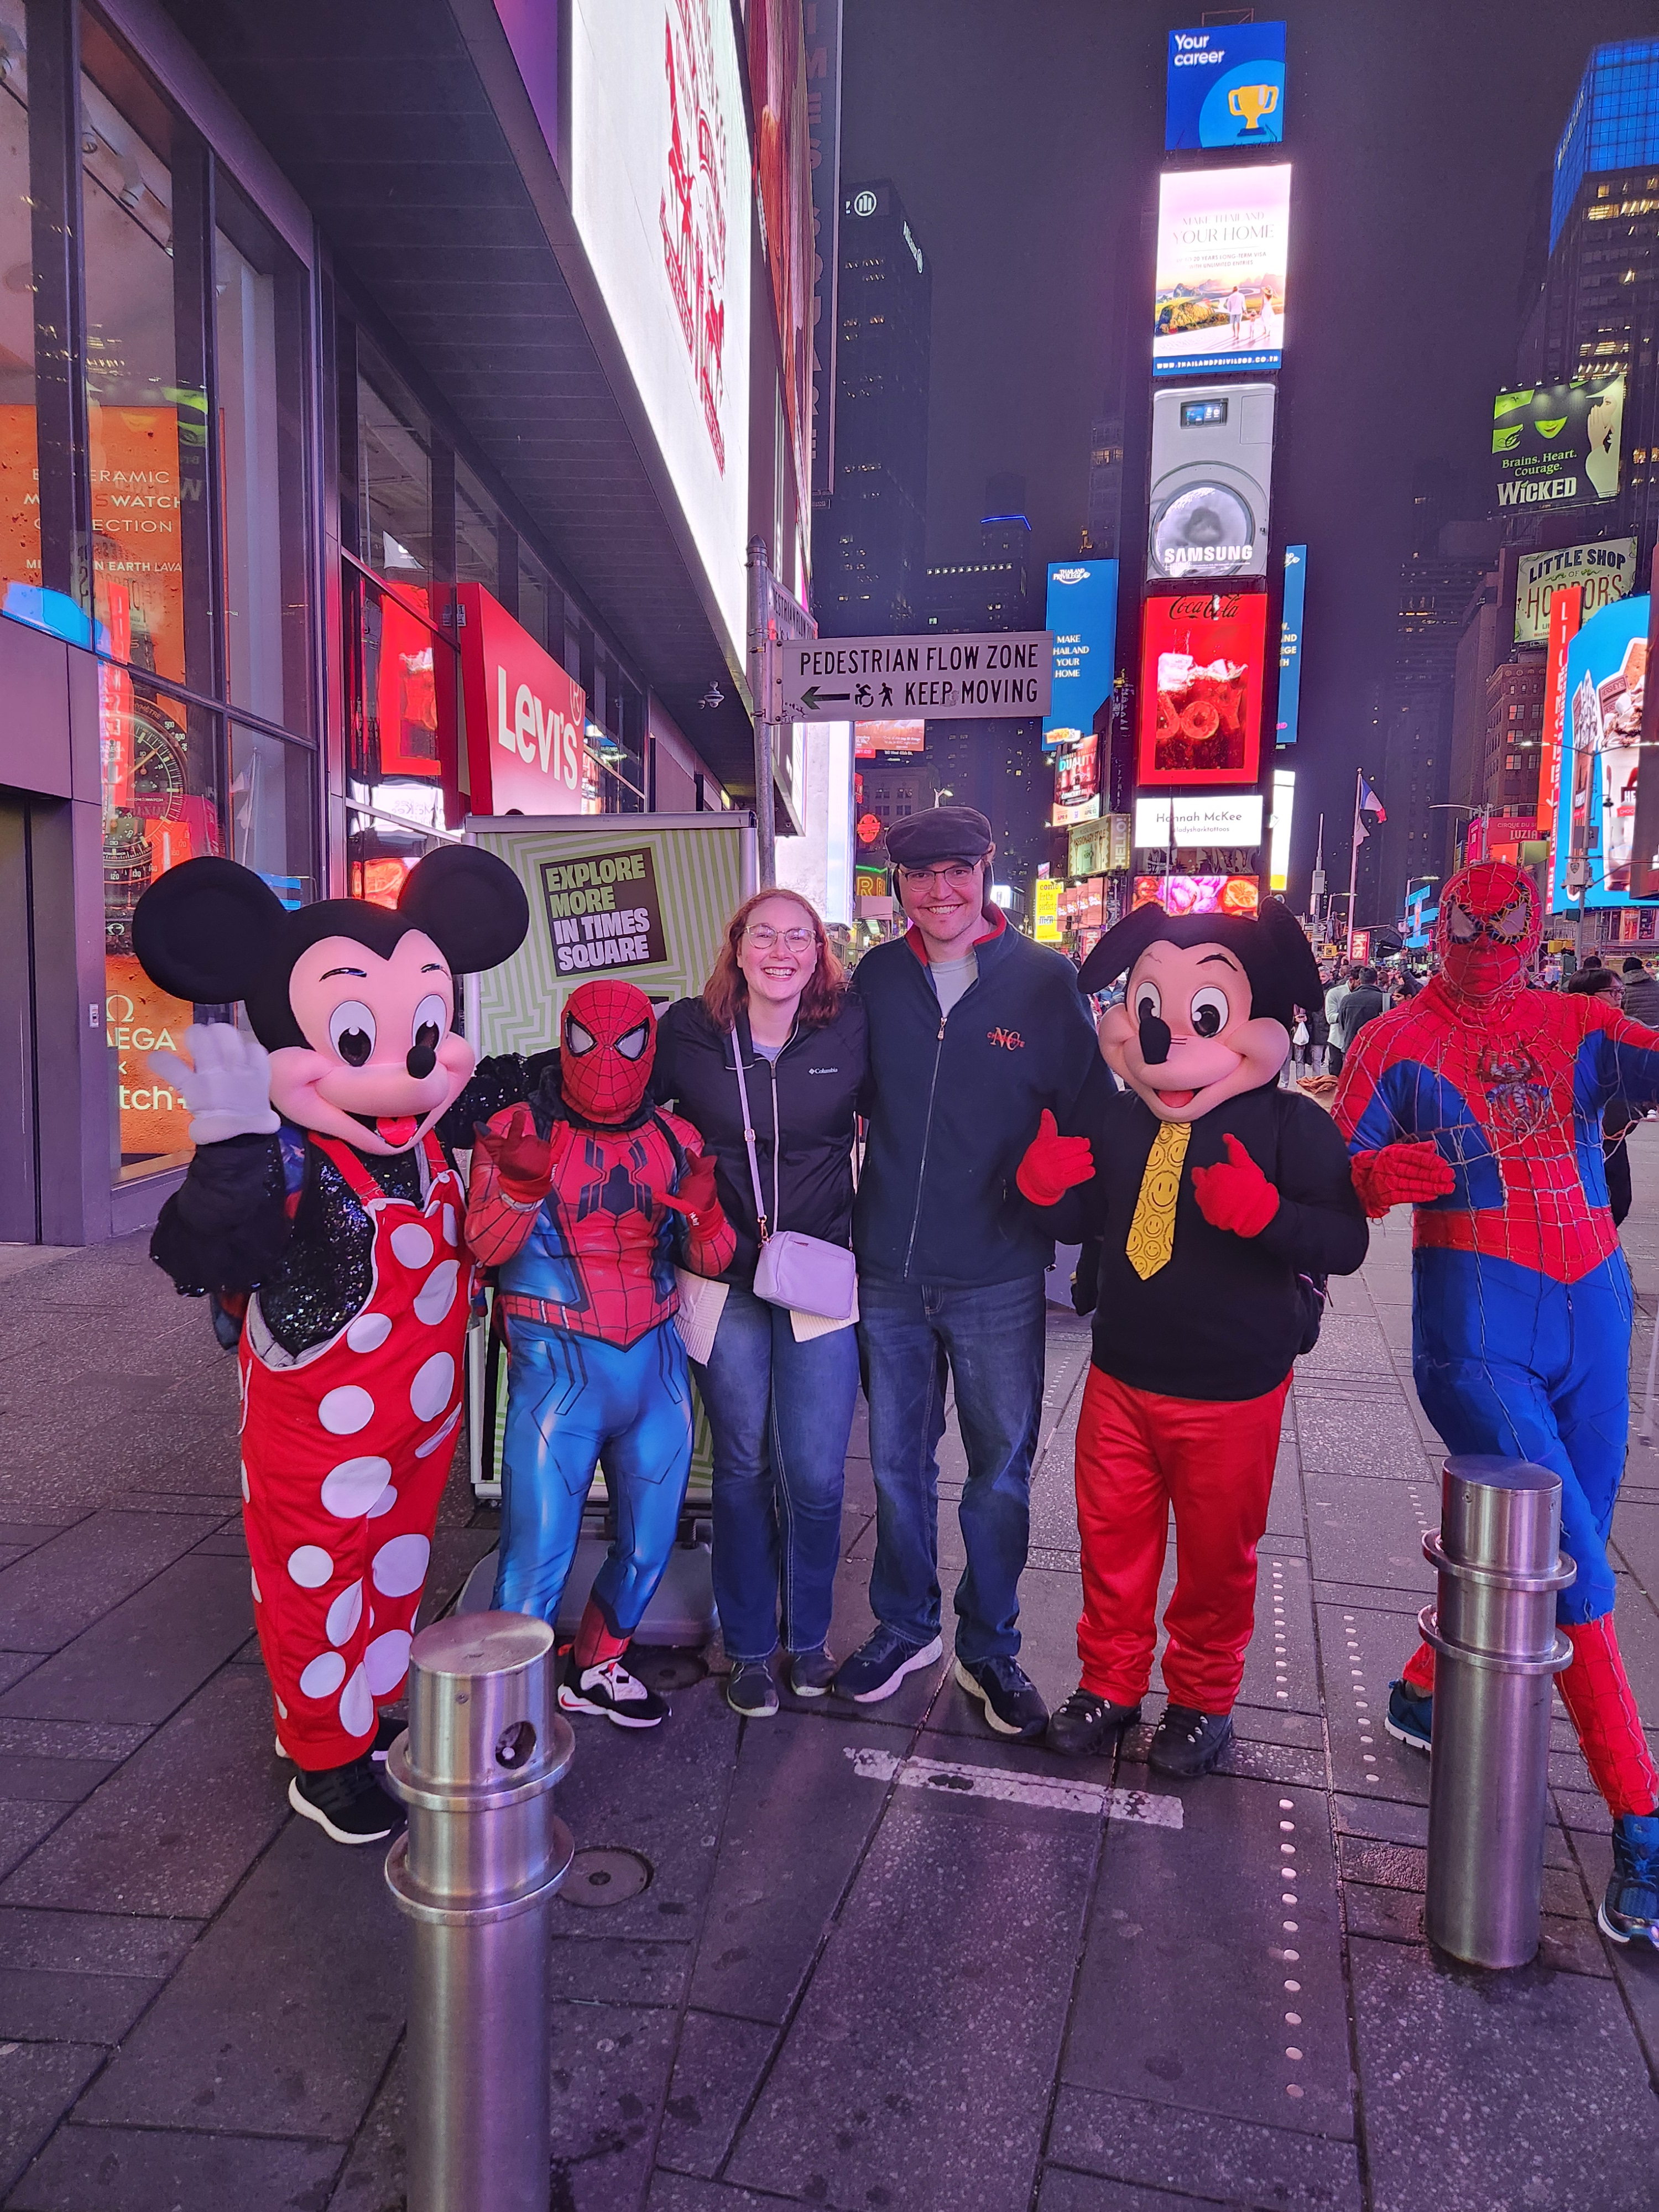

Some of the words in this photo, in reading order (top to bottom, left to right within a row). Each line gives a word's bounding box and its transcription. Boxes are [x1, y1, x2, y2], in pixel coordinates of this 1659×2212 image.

[1175, 34, 1209, 51] Your
[1174, 50, 1224, 66] career
[1183, 216, 1209, 225] MAKE
[1216, 211, 1264, 223] THAILAND
[1173, 227, 1218, 244] YOUR
[1224, 224, 1274, 241] HOME
[1502, 456, 1540, 469] Brains.
[1542, 449, 1577, 462] Heart.
[1515, 463, 1563, 477] Courage.
[1164, 545, 1253, 563] SAMSUNG
[110, 562, 150, 572] EARTH
[1529, 550, 1583, 585] LITTLE
[1587, 549, 1626, 570] SHOP
[1527, 575, 1622, 628] HOORS
[1057, 635, 1081, 643] MAKE
[800, 648, 919, 676] PEDESTRIAN
[927, 646, 979, 671] FLOW
[987, 644, 1039, 669] ZONE
[1052, 646, 1089, 655] HAILAND
[1056, 658, 1080, 666] YOUR
[1055, 669, 1081, 679] HOME
[905, 681, 953, 706] KEEP
[961, 679, 1037, 704] MOVING
[498, 665, 578, 790] Levi's
[1059, 753, 1095, 772] DUALITY
[1156, 812, 1199, 822] Hannah
[1204, 811, 1242, 821] McKee
[1115, 817, 1126, 866] HELLO!
[1510, 830, 1537, 840] LUZIA
[545, 854, 646, 893] EXPLORE
[549, 885, 615, 919] MORE
[553, 918, 580, 945] IN
[581, 907, 650, 941] TIMES
[557, 935, 650, 971] SQUARE
[1353, 933, 1367, 958] tkts
[107, 1027, 177, 1051] MEGA
[990, 1026, 1020, 1051] NC
